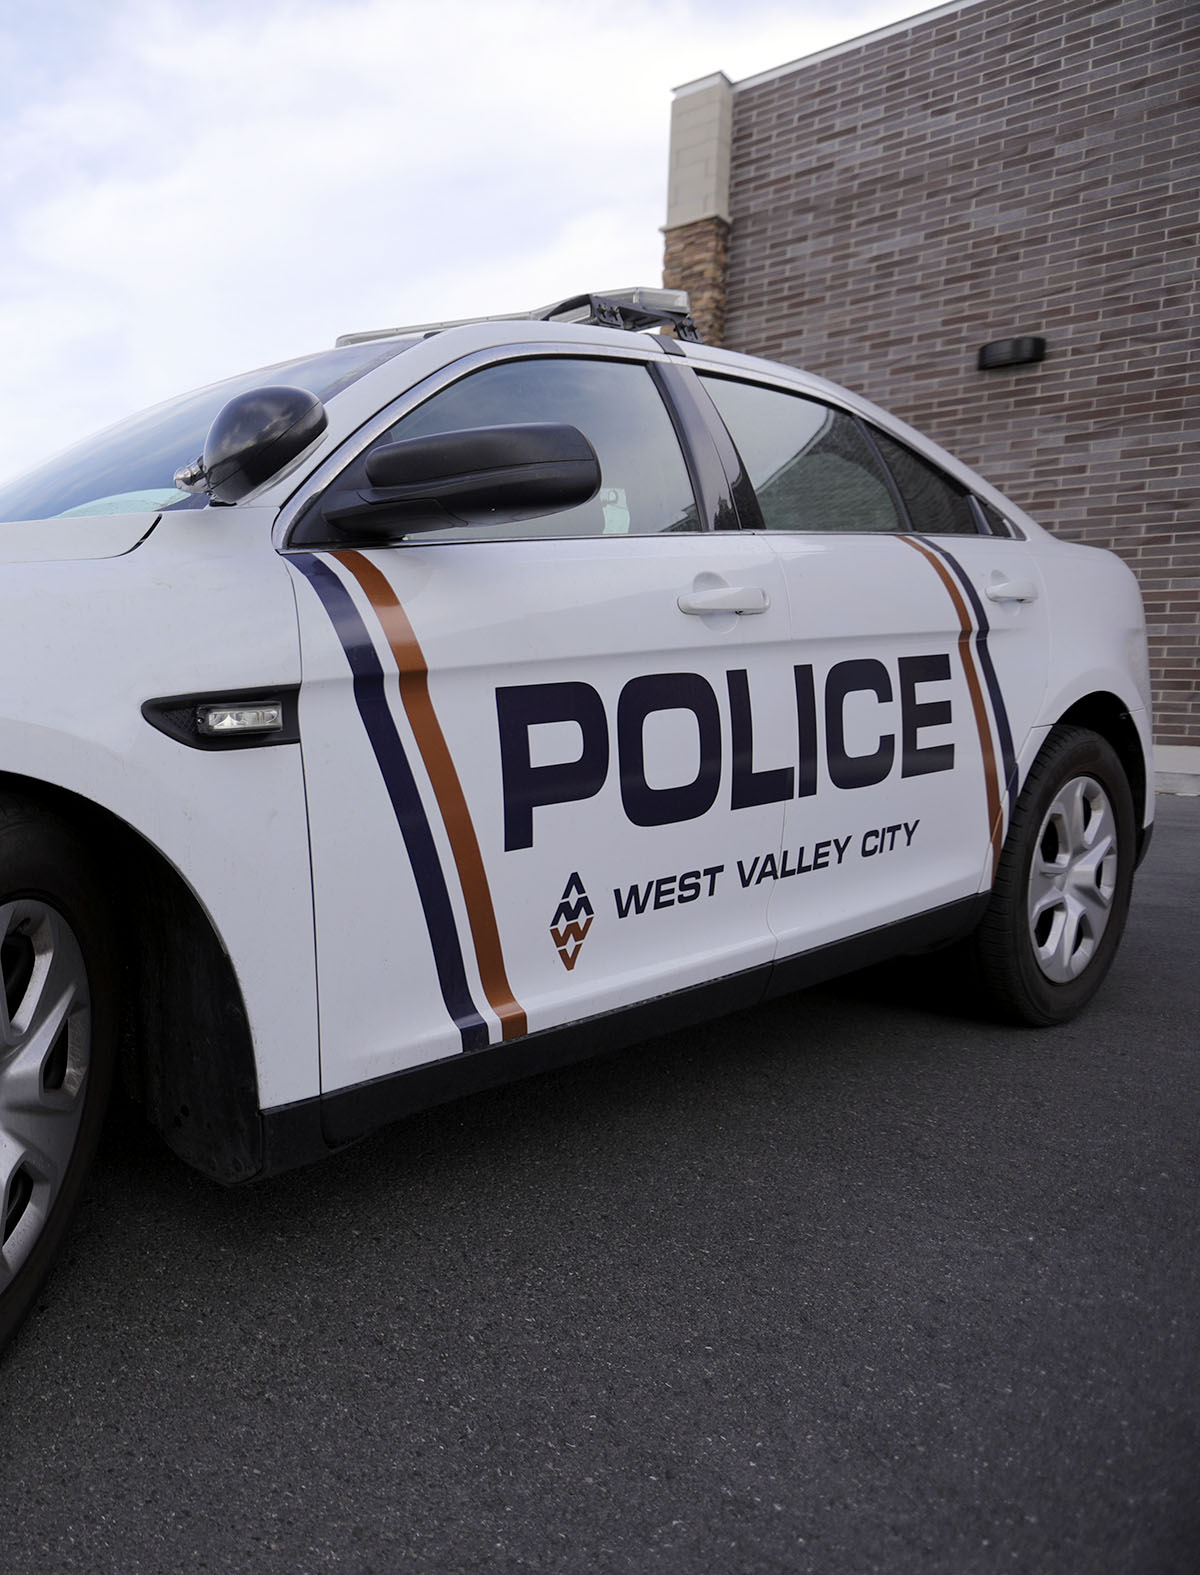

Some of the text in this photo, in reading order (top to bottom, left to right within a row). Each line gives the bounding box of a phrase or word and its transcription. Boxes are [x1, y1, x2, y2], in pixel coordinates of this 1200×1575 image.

[495, 654, 954, 852] POLICE
[614, 819, 920, 919] WEST VALLEY CITY
